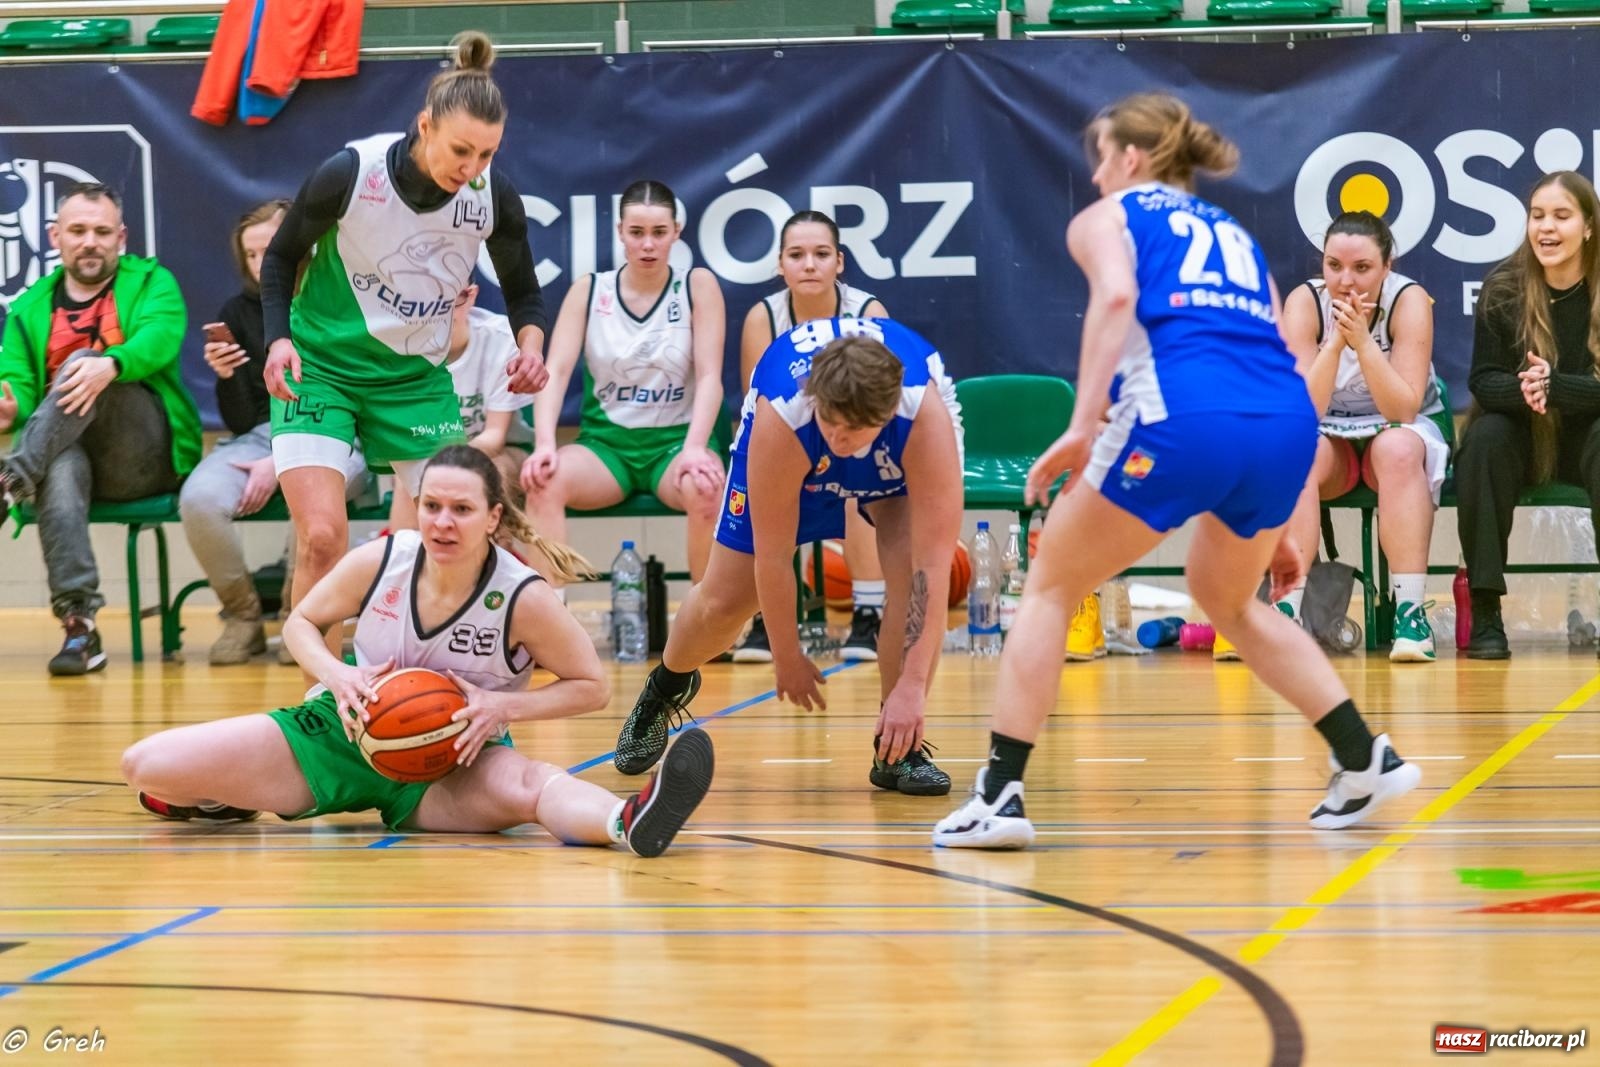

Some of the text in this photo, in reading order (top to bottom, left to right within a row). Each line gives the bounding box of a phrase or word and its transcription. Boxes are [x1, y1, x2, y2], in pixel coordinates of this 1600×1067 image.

[452, 199, 488, 231] 14
[283, 394, 328, 423] 14
[448, 622, 501, 657] 33
